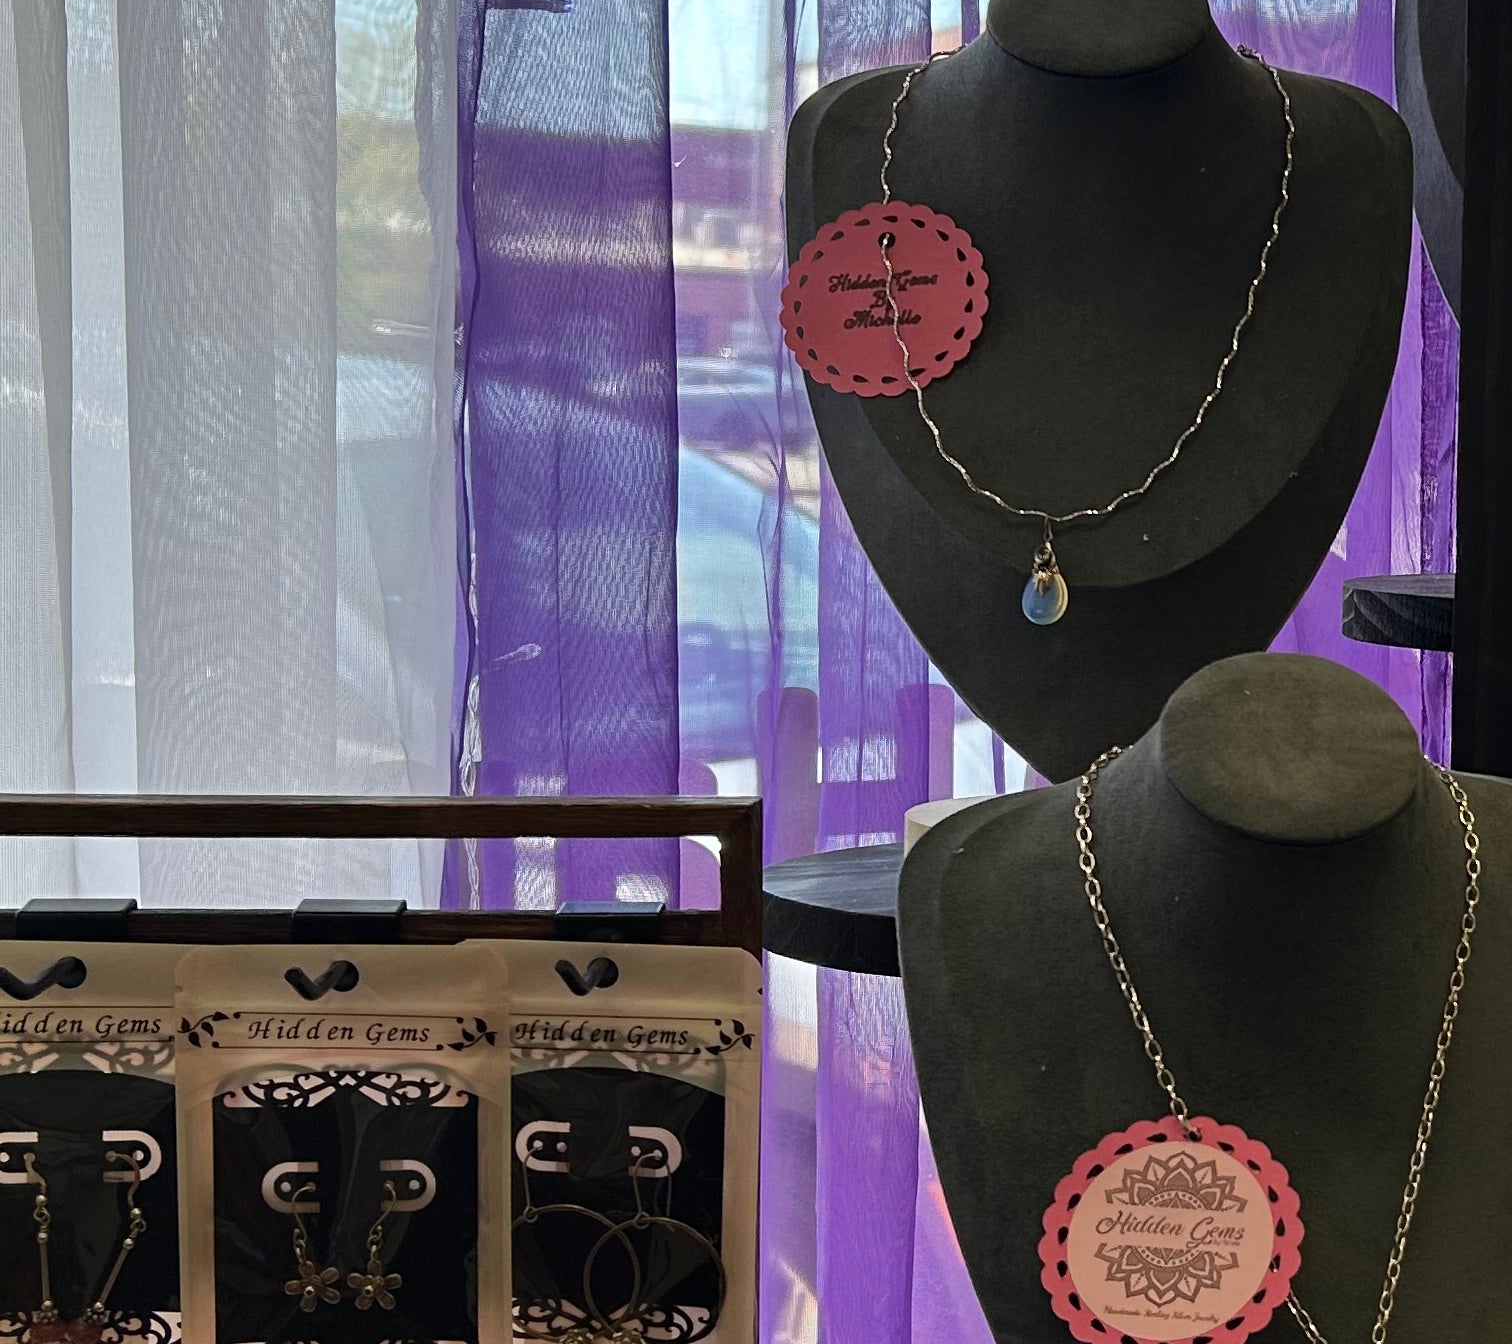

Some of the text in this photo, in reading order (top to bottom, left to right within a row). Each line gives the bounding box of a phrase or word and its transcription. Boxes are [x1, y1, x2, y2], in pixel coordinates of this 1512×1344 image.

[0, 1011, 162, 1039] idden Gems
[249, 1018, 431, 1045] Hidden Gems
[515, 1019, 689, 1048] Hidden Gems
[1096, 1210, 1246, 1249] Hidden Gems
